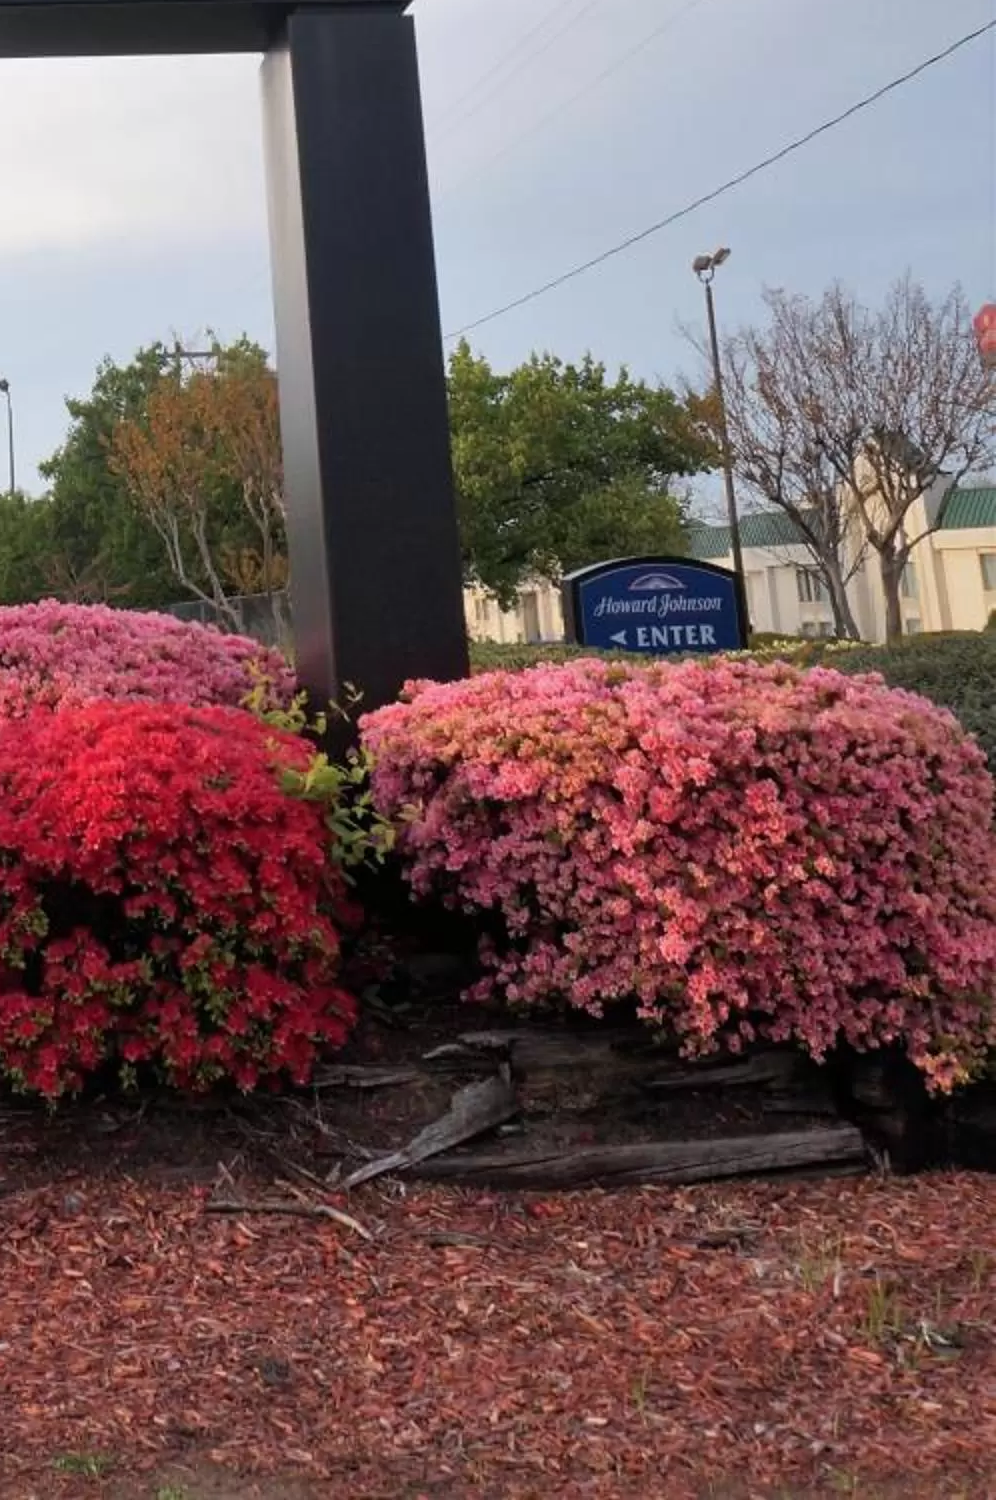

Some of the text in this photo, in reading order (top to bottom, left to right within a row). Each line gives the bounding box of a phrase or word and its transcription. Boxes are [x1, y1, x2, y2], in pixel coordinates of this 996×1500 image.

[593, 593, 723, 618] Howard Johnson
[636, 625, 717, 648] ENTER
